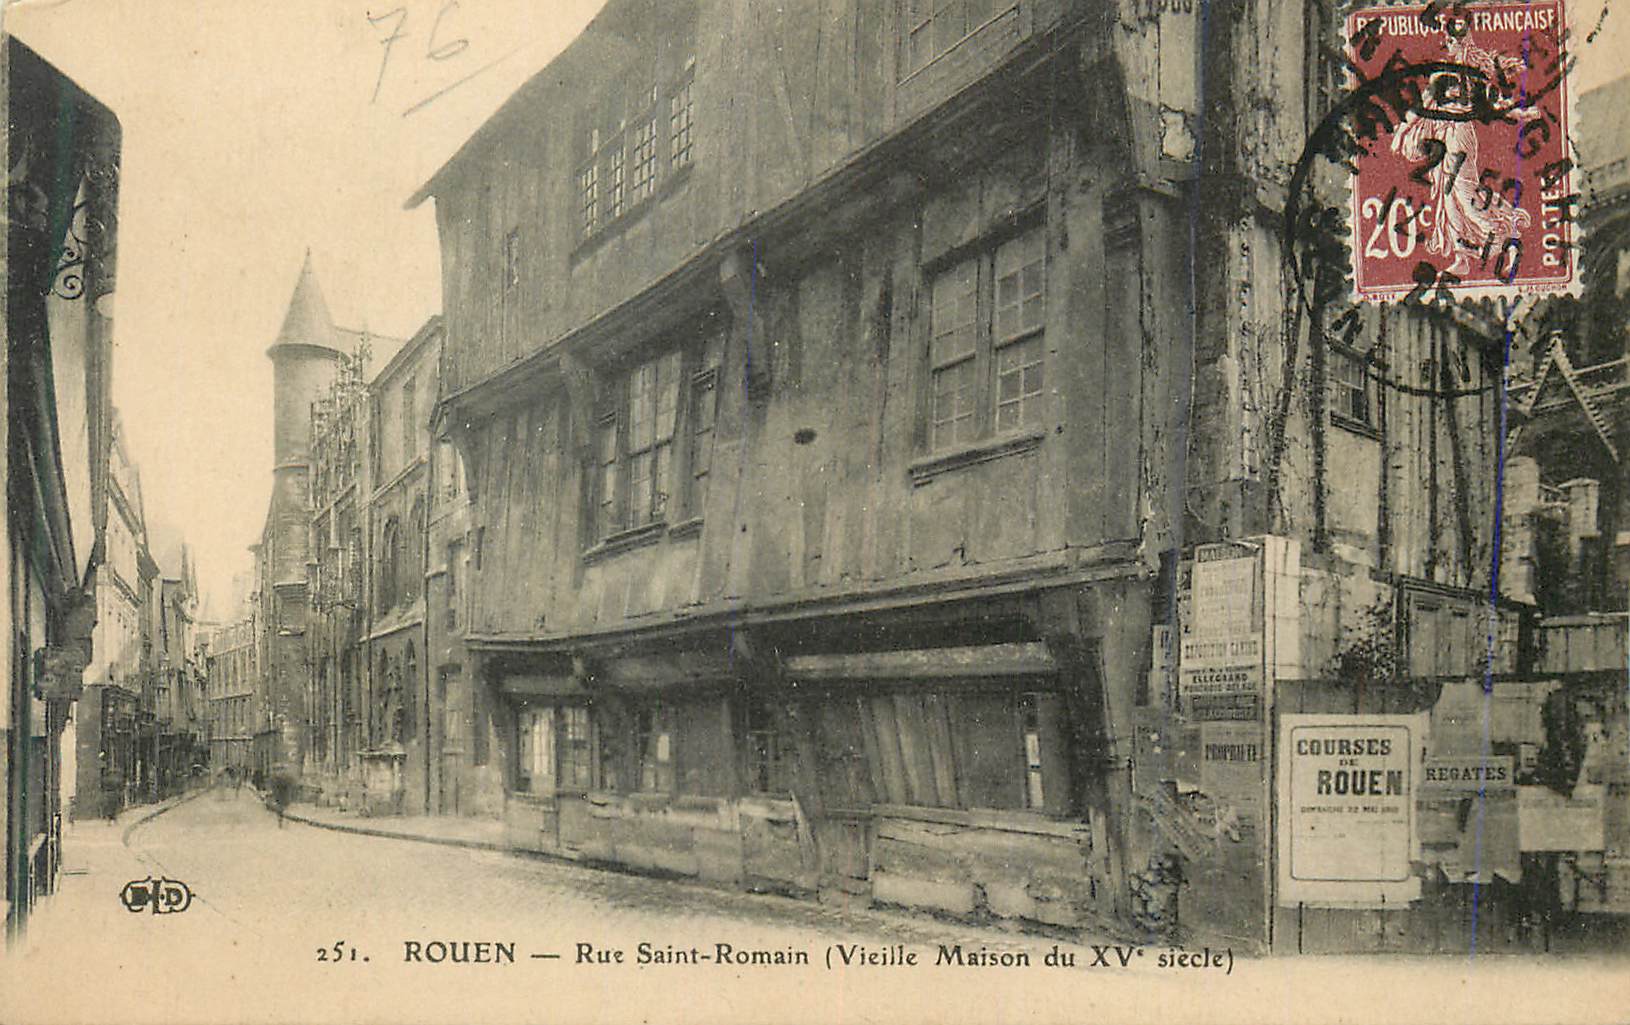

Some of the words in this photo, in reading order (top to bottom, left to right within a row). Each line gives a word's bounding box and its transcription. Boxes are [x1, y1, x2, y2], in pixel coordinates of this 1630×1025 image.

[1297, 738, 1392, 756] COURSES
[1339, 758, 1359, 767] DE
[1317, 769, 1403, 796] ROUEN
